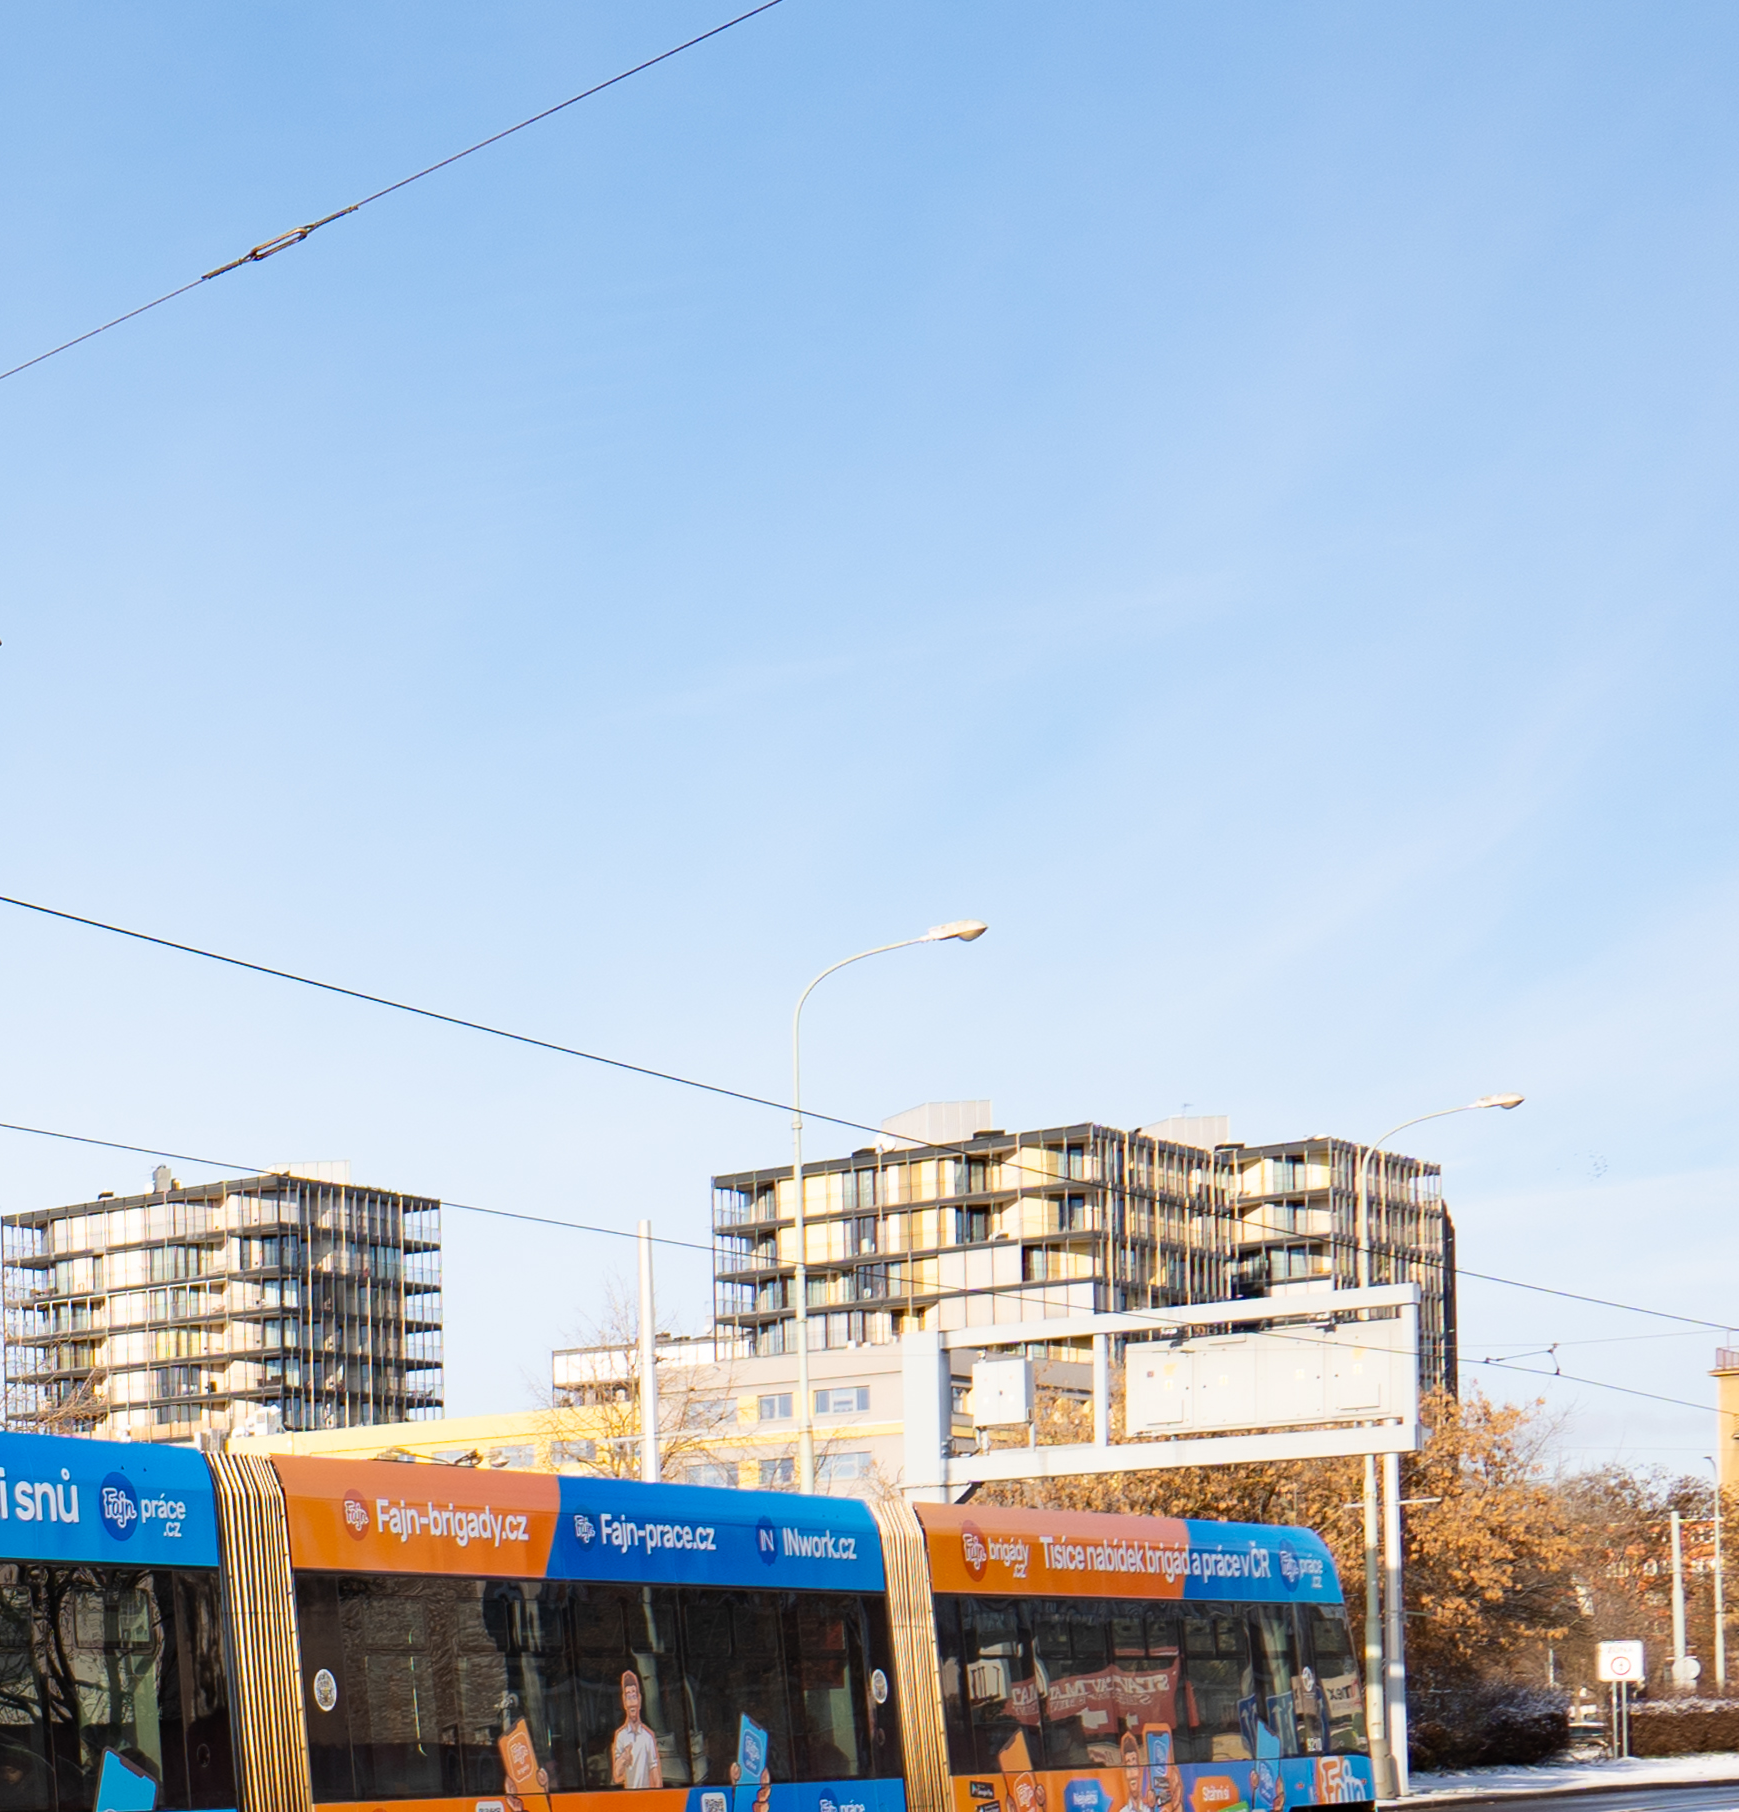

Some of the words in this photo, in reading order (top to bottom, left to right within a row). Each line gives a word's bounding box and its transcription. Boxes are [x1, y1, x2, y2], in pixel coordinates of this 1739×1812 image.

[15, 1467, 80, 1524] snů
[103, 1487, 137, 1528] Fajn
[141, 1494, 186, 1523] práce
[163, 1520, 182, 1537] .cz
[376, 1498, 529, 1547] Fajn-brigady.cz
[600, 1514, 716, 1555] Fajn-prace.cz
[783, 1527, 857, 1560] INwork.cz
[988, 1537, 1030, 1567] brigády
[1039, 1535, 1085, 1571] Tisíce
[1086, 1538, 1145, 1573] nabídek
[1145, 1541, 1190, 1583] brigád
[1192, 1552, 1201, 1575] a
[1202, 1545, 1241, 1583] práce
[1241, 1554, 1250, 1577] v
[1249, 1540, 1271, 1578] ČR
[1299, 1553, 1323, 1580] práce
